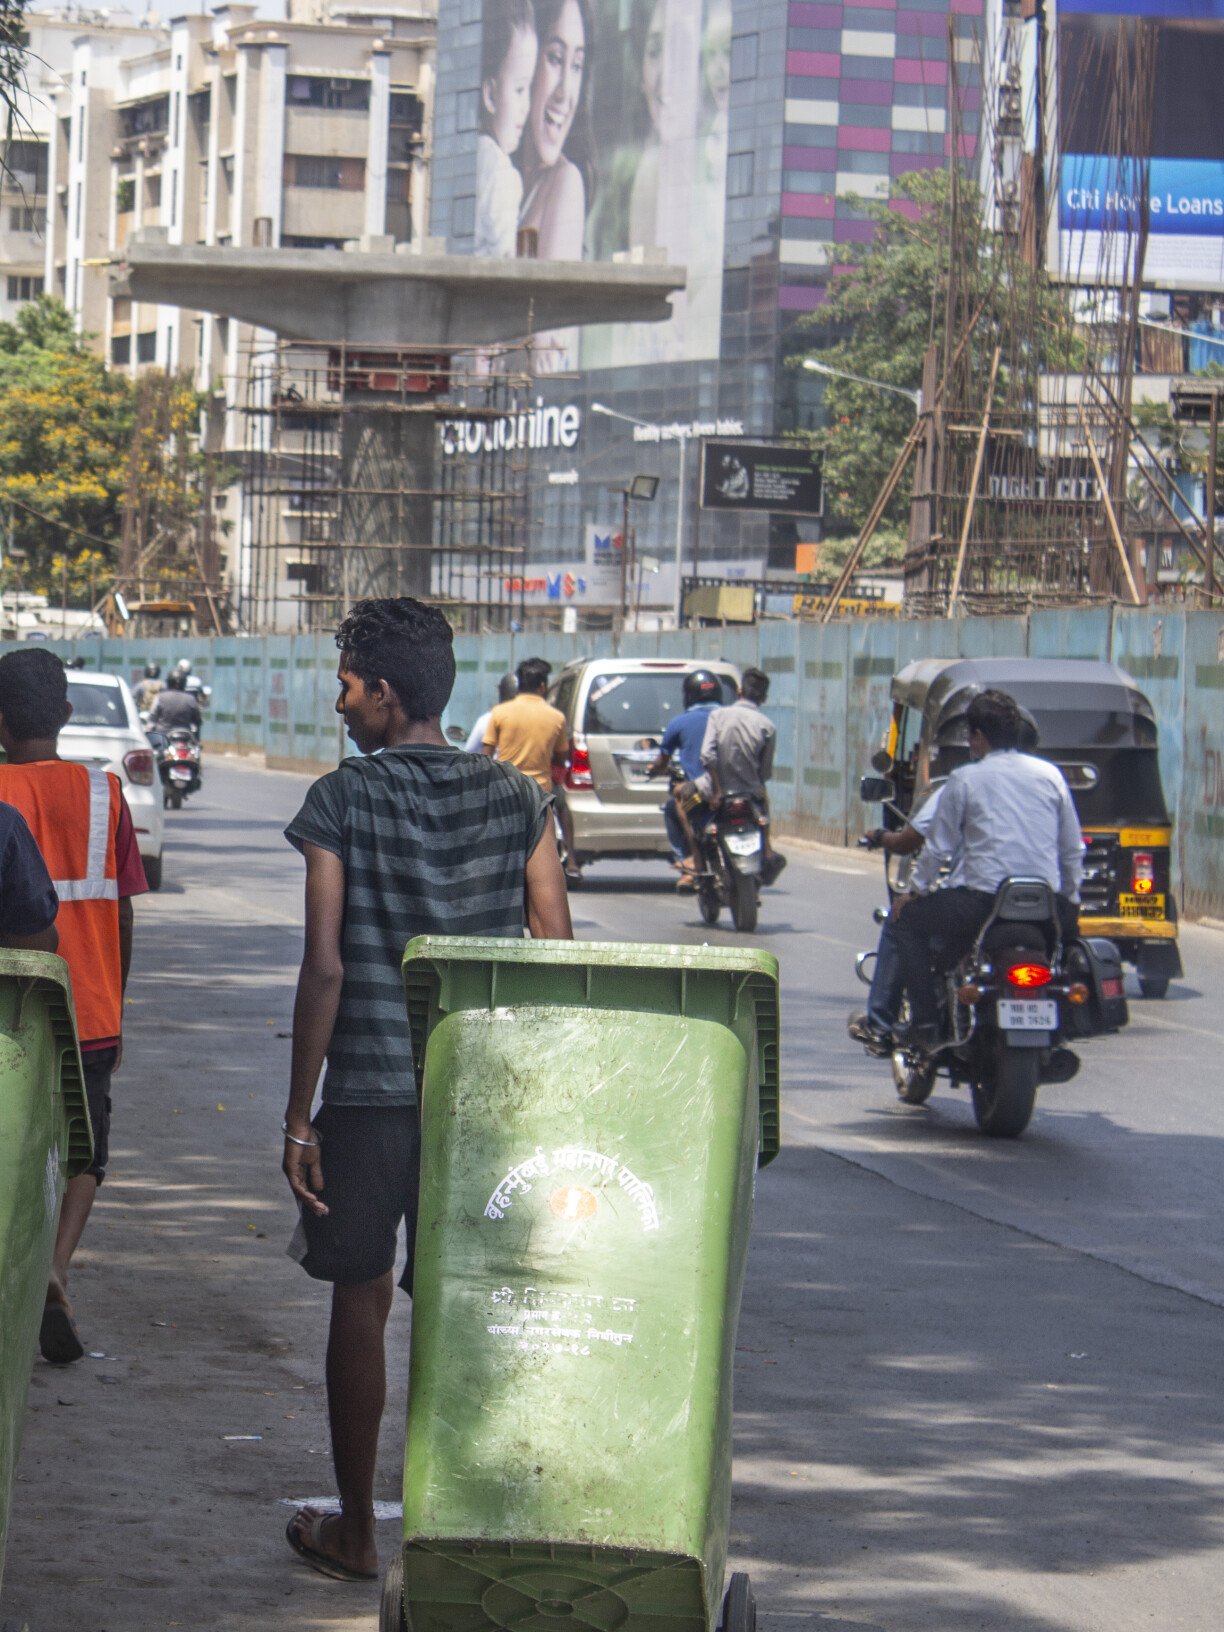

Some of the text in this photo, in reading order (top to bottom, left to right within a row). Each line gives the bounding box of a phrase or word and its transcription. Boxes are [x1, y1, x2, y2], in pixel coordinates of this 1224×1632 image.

[1067, 188, 1223, 216] Citi Hoe Loans
[483, 1145, 660, 1232] बृहन्मुंबई महानगर पालिका
